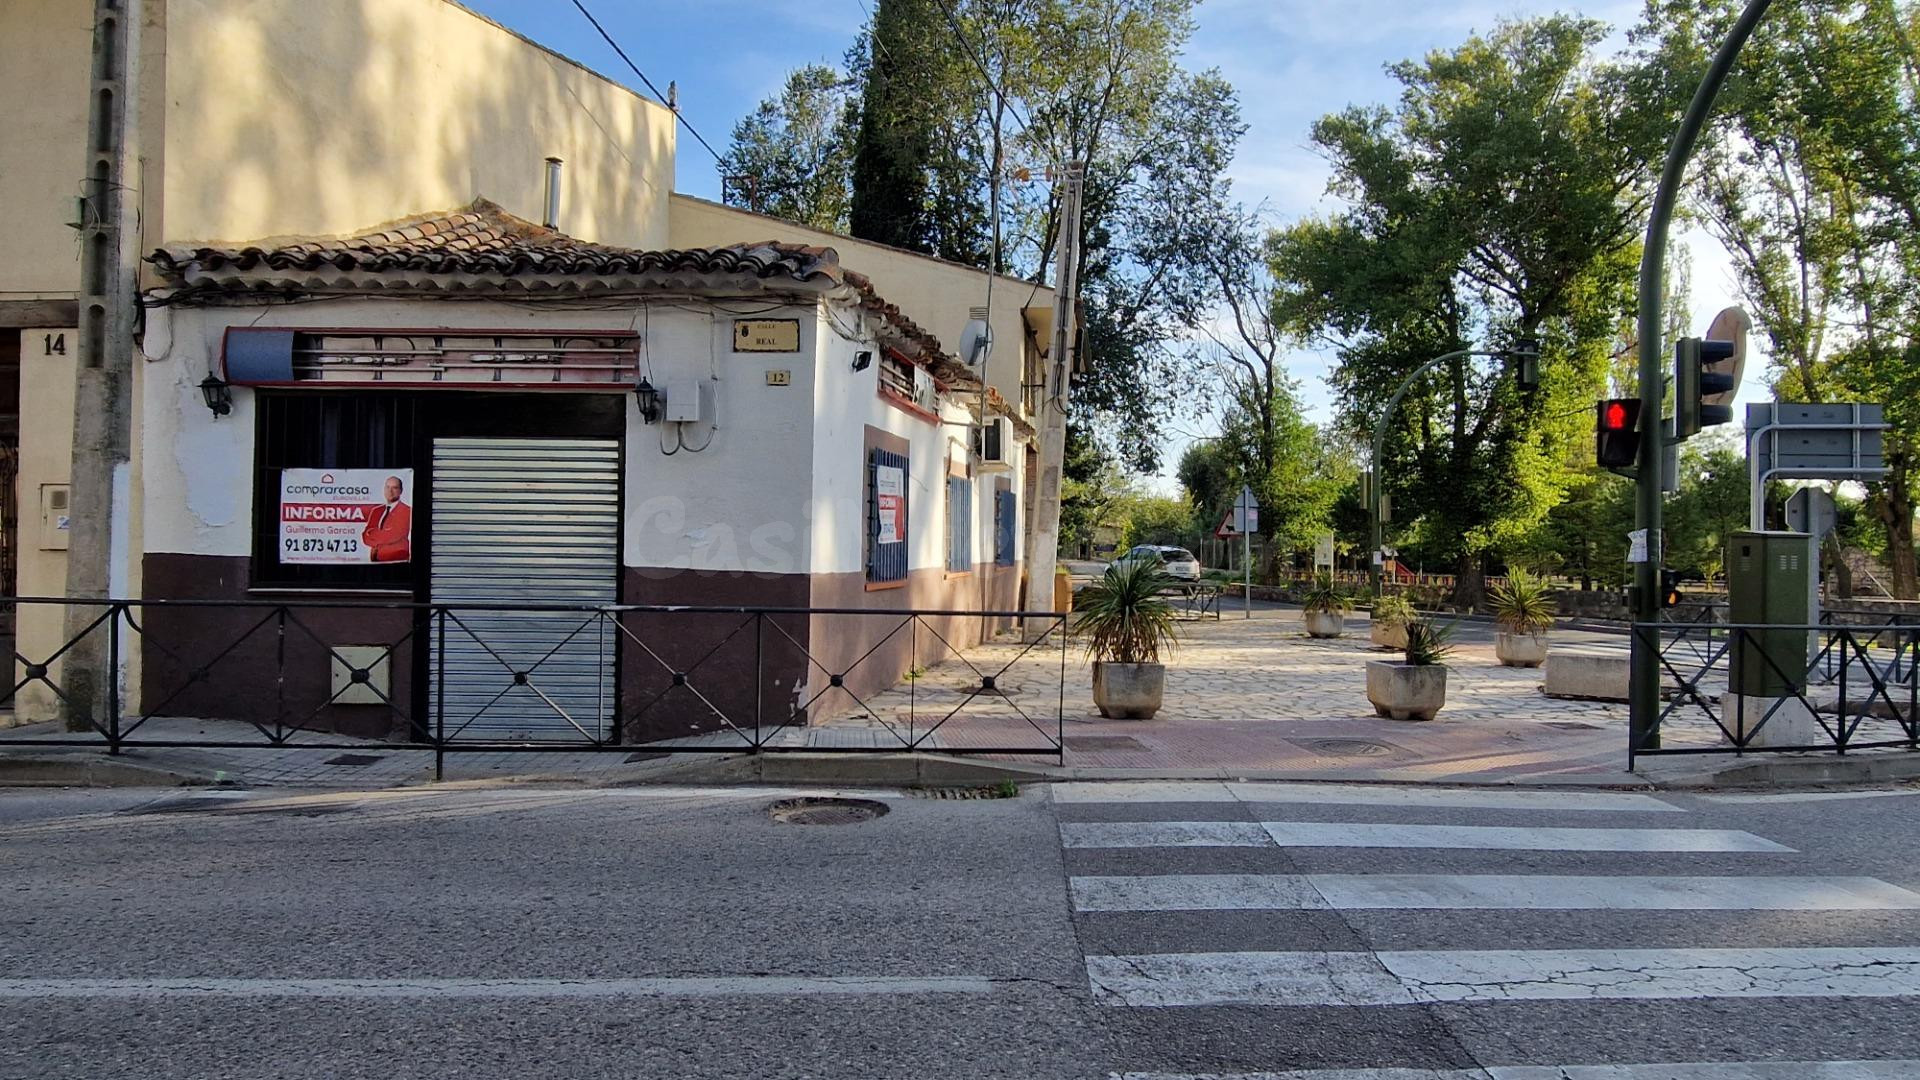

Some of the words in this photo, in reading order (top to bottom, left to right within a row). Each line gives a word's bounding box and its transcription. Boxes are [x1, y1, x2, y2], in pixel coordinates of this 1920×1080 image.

[44, 333, 66, 356] 14
[773, 373, 785, 382] 12
[286, 485, 369, 497] comprarcasa
[285, 507, 365, 520] INFORMA
[286, 525, 325, 535] Guillermo
[285, 538, 299, 551] 91
[303, 538, 324, 551] 873
[327, 539, 340, 552] 47
[344, 539, 357, 552] 13
